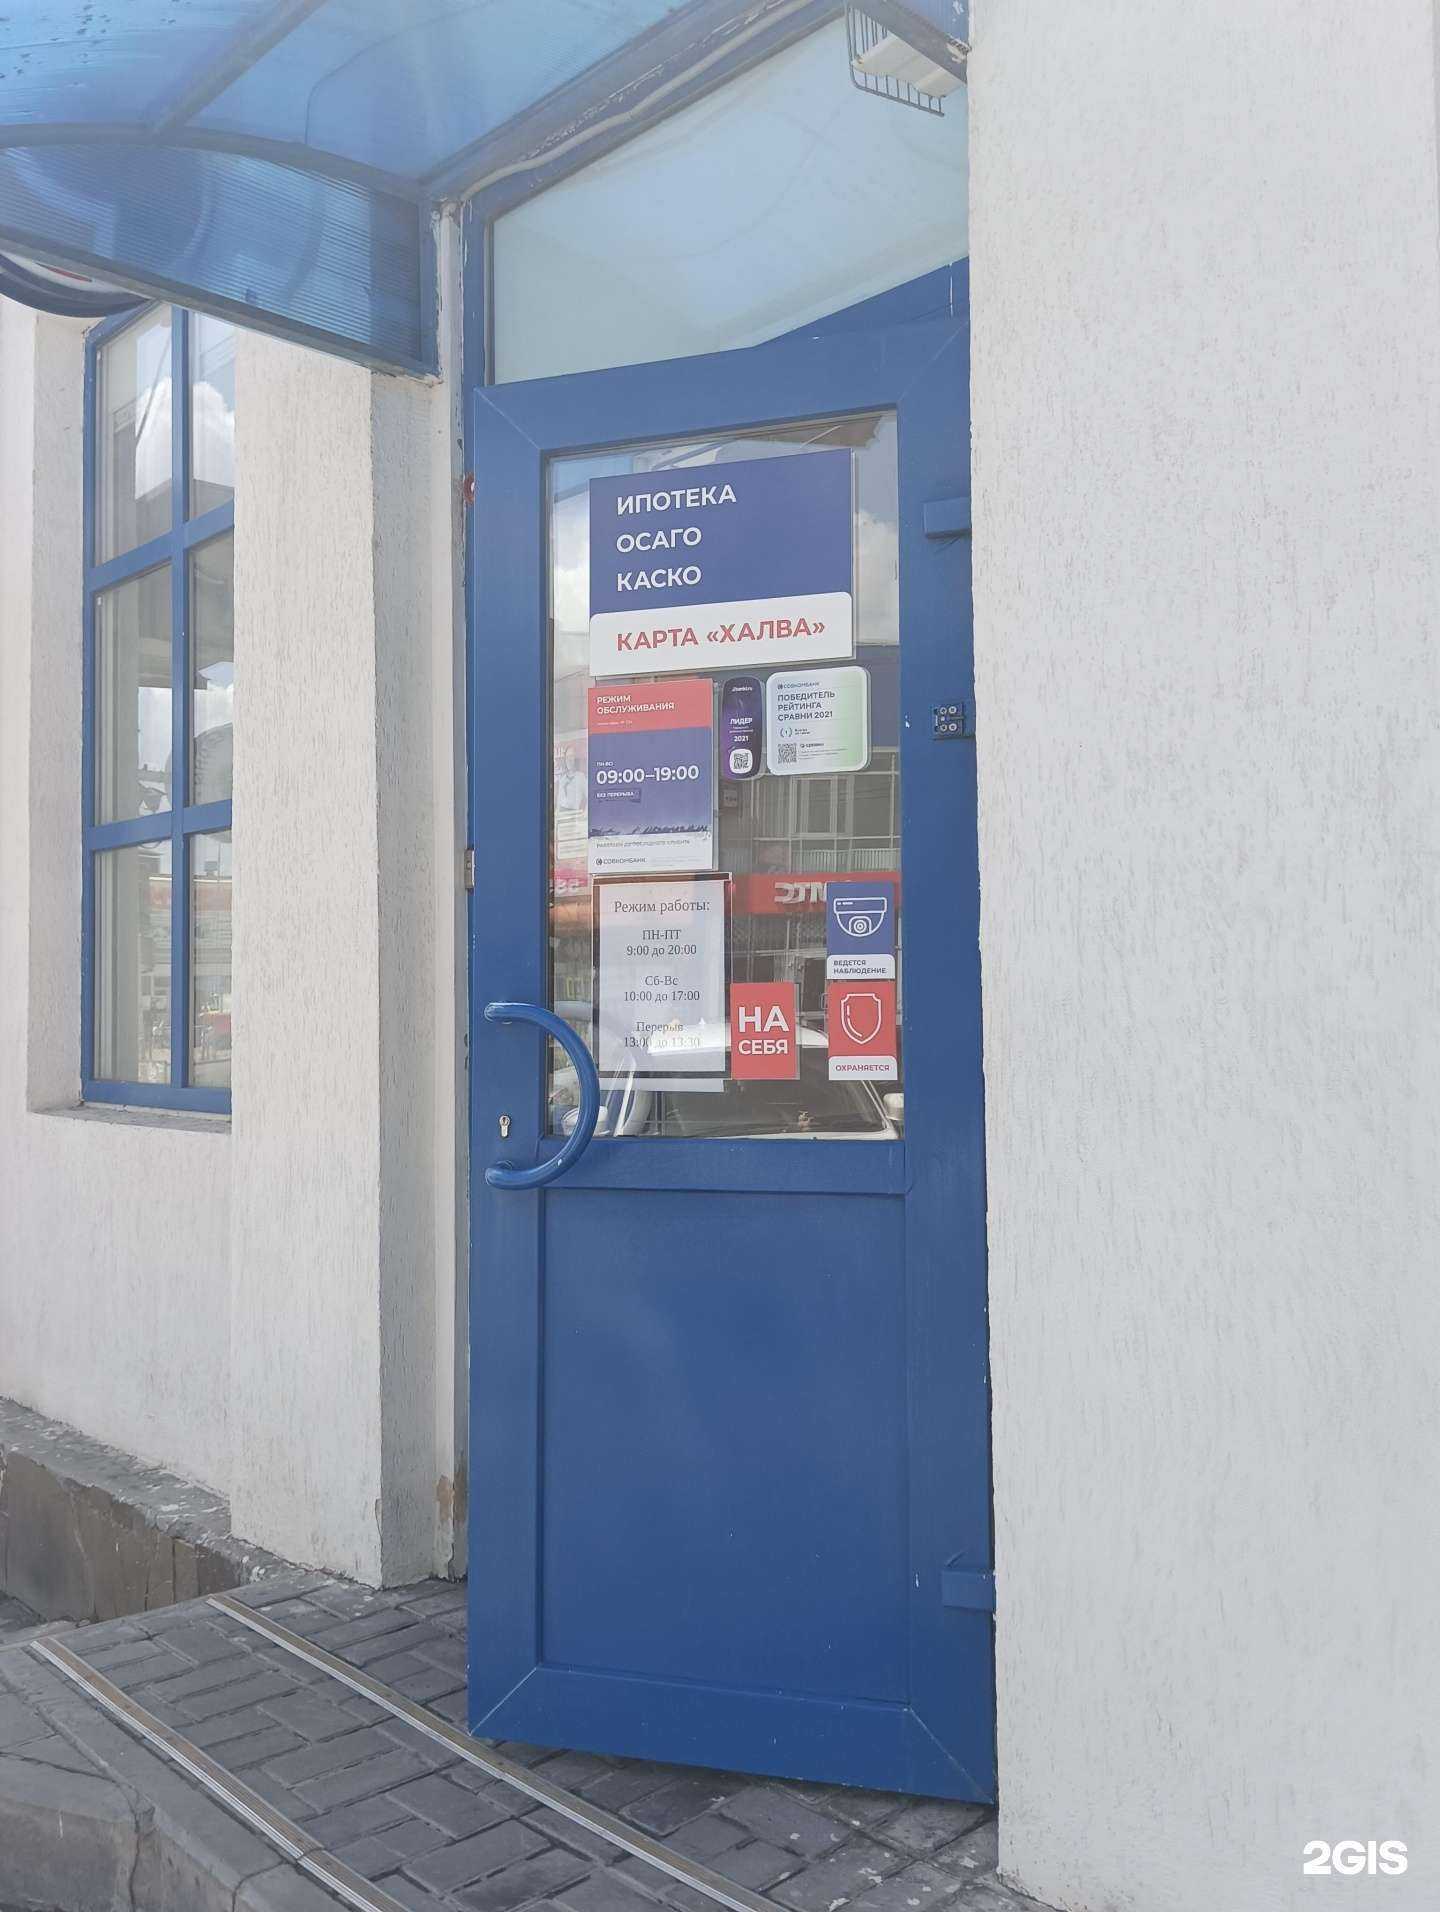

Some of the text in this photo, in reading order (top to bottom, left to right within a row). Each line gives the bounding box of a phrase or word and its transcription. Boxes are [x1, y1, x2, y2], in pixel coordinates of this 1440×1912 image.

[616, 484, 737, 516] ИПОТЕКА
[616, 526, 702, 553] ОСАГО
[616, 565, 702, 592] КАСКО
[616, 617, 826, 652] КАРТА «ХАЛВА»
[597, 695, 632, 704] РЕЖИМ
[777, 691, 836, 702] ПОБЕДИТЕЛЬ
[596, 702, 675, 715] ОБСЛУЖИВАНИЯ
[777, 702, 823, 712] РЕЙТИНГА
[729, 717, 753, 725] ЛИДЕР
[777, 711, 833, 722] СРАВНИ 2021
[614, 899, 710, 915] Режим работы:
[642, 929, 682, 940] ПН-ПТ
[626, 944, 697, 958] 9:00 до 20:00
[833, 967, 887, 975] НАБЛЮДЕНИЕ
[644, 975, 679, 986] Сб-Вс
[624, 990, 700, 1003] 10:00 до 17:00
[738, 1006, 790, 1033] НА
[636, 1022, 684, 1036] Перерыв
[738, 1039, 789, 1055] СЕБЯ
[835, 1064, 890, 1073] ОХРАНЯЕТСЯ
